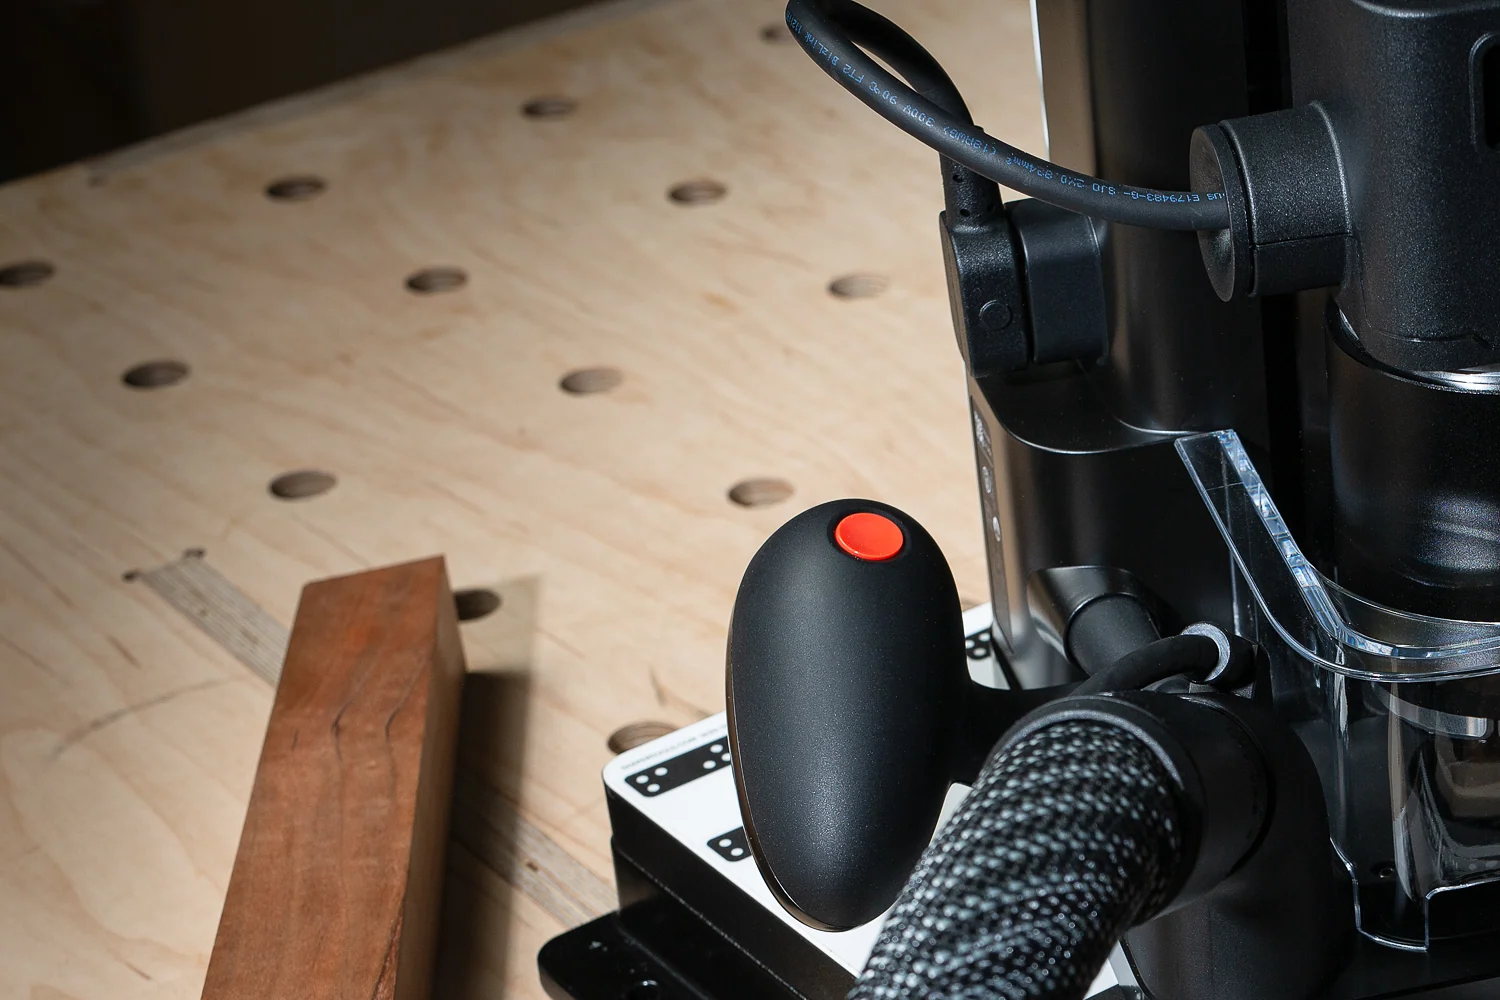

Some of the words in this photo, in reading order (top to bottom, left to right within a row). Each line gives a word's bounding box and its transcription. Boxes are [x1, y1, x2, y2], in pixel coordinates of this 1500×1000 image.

[804, 31, 840, 66] BizLink
[843, 63, 865, 84] FT2
[902, 104, 935, 127] 300V
